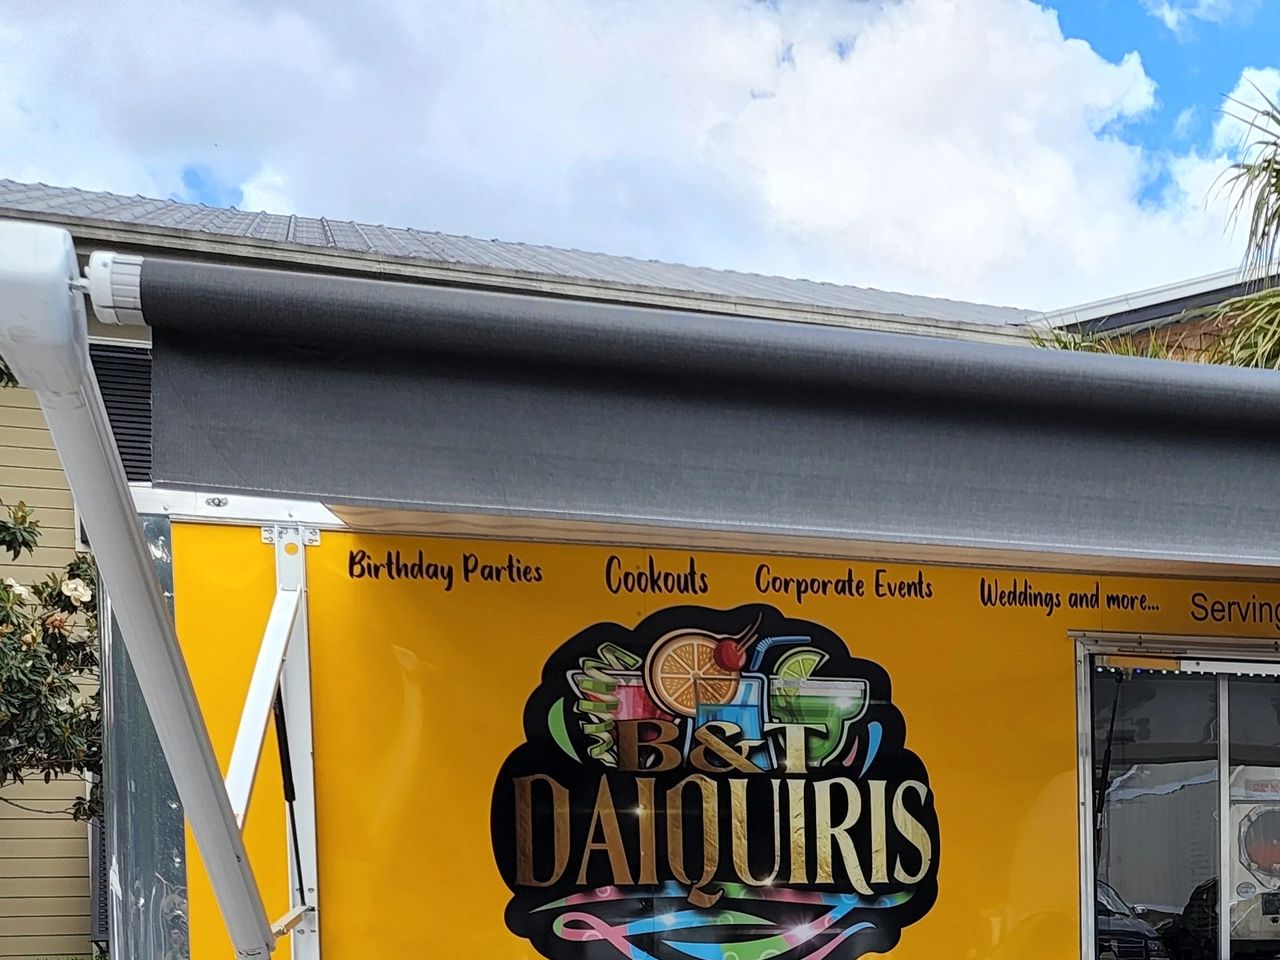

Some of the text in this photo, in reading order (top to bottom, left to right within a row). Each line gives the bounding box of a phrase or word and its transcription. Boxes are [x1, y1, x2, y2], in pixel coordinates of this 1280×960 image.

[349, 550, 543, 591] Birthday Parties
[605, 554, 709, 594] Cookouts
[755, 563, 933, 604] Corporate Events
[979, 577, 1160, 616] Weddings and more...
[616, 719, 828, 774] B&T
[512, 773, 933, 909] DAIQUIRIS
